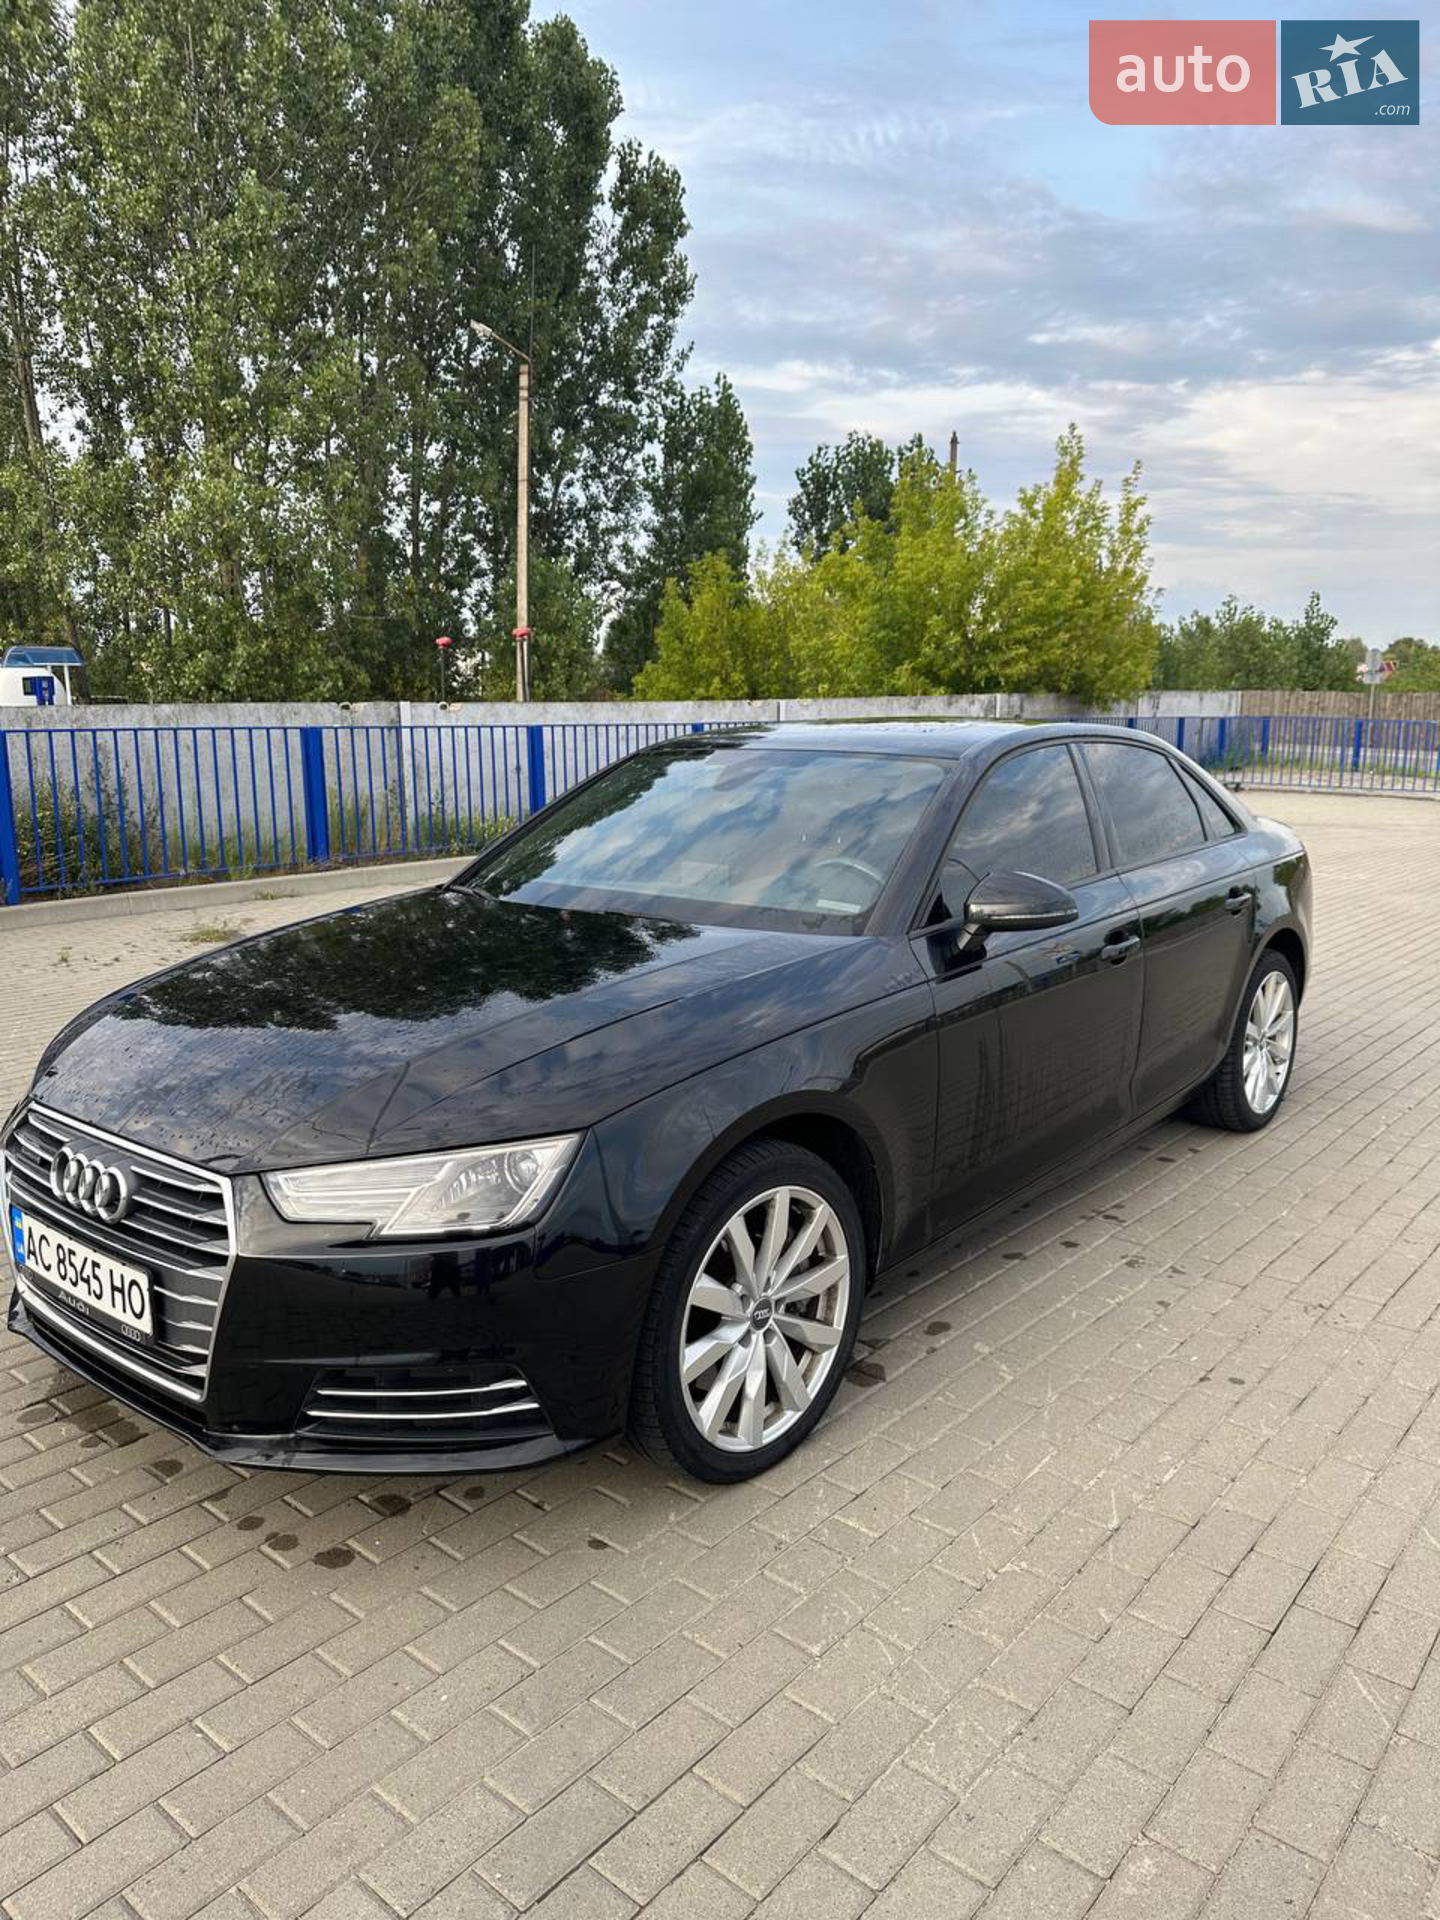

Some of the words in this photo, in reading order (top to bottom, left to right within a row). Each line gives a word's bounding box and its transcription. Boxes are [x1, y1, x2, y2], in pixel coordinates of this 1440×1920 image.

[27, 1226, 52, 1271] AC
[56, 1243, 103, 1301] 8545
[109, 1268, 145, 1320] HO
